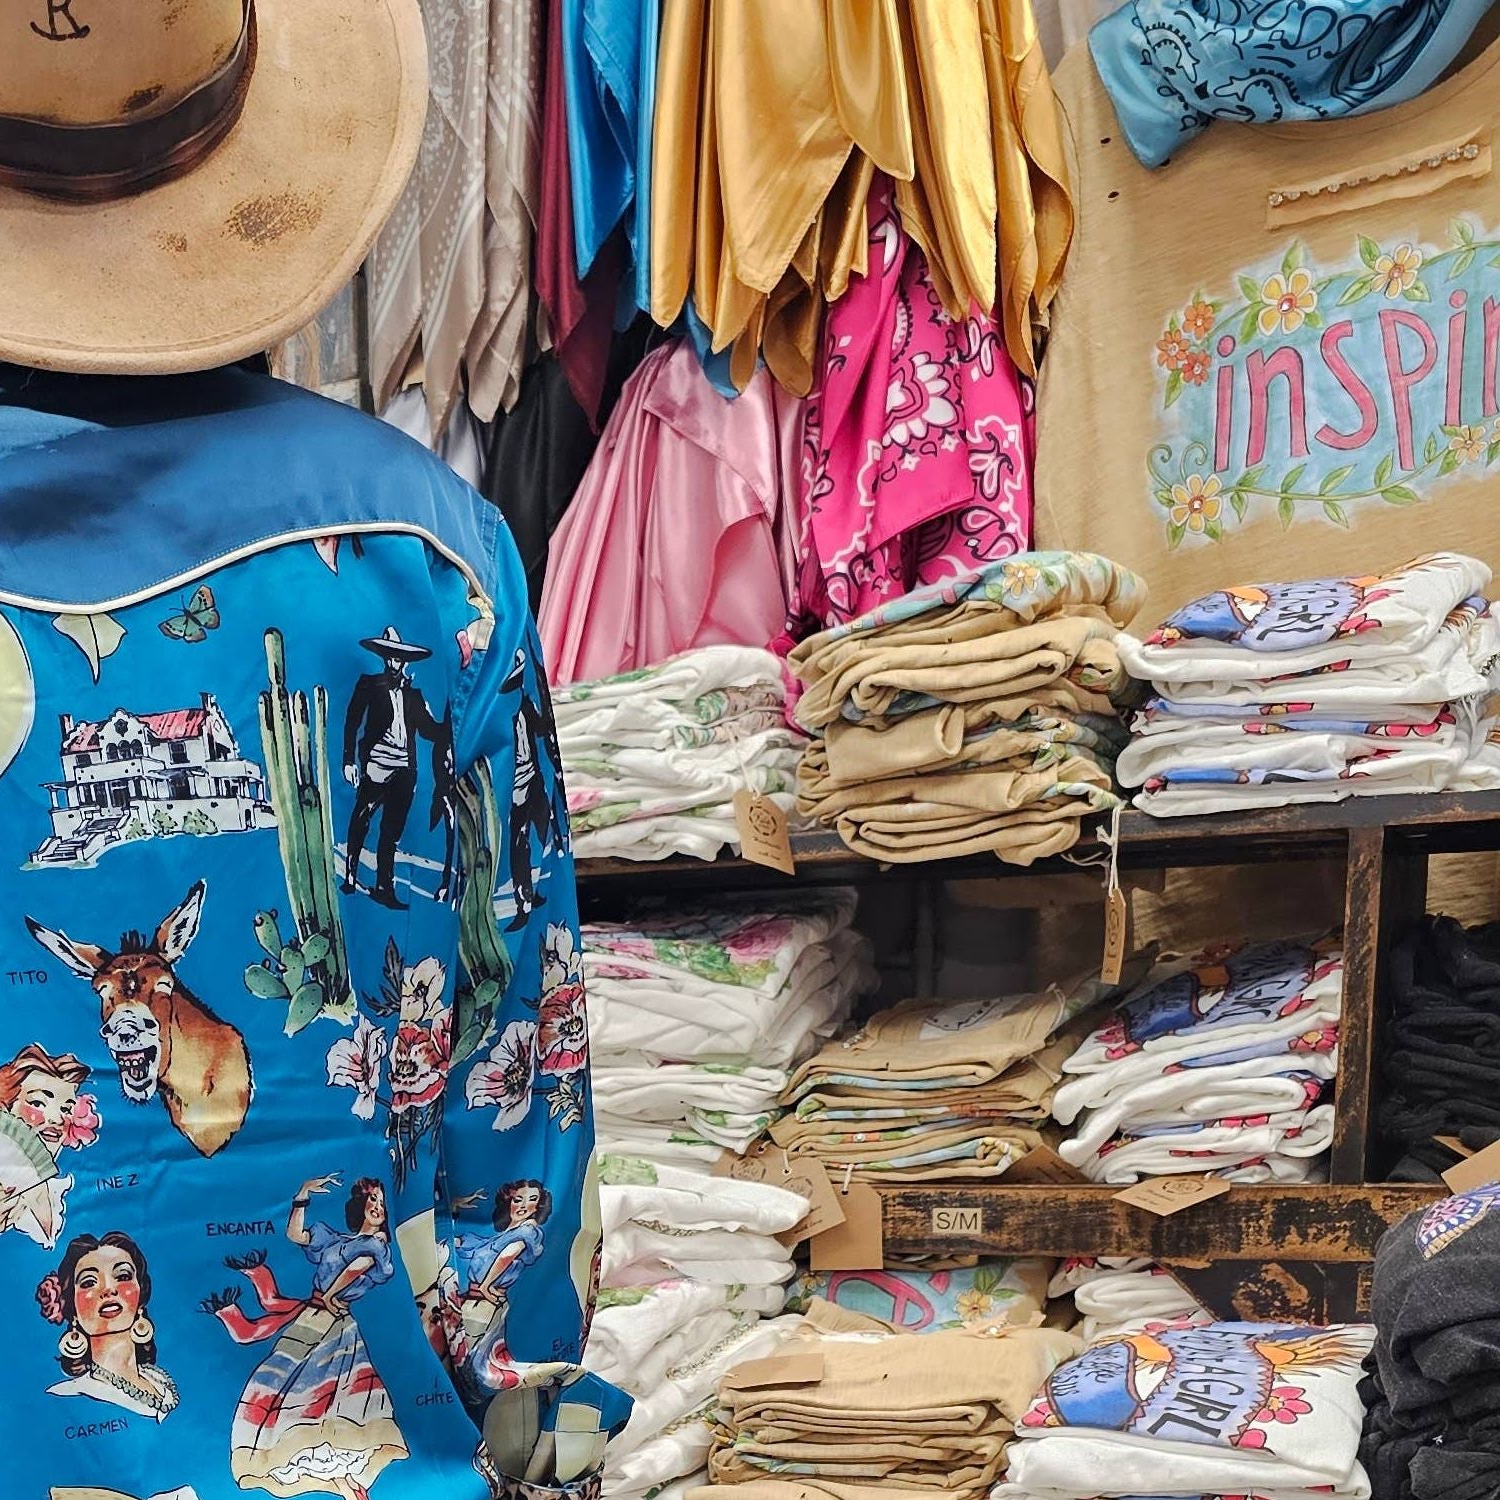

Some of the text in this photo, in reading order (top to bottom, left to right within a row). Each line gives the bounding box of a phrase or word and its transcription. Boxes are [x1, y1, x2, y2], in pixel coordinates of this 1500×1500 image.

[5, 969, 48, 985] TITO
[205, 1220, 276, 1237] ENCANTA
[936, 1211, 978, 1230] S/M
[1147, 1378, 1245, 1438] GIRL
[64, 1416, 129, 1440] CARMEN
